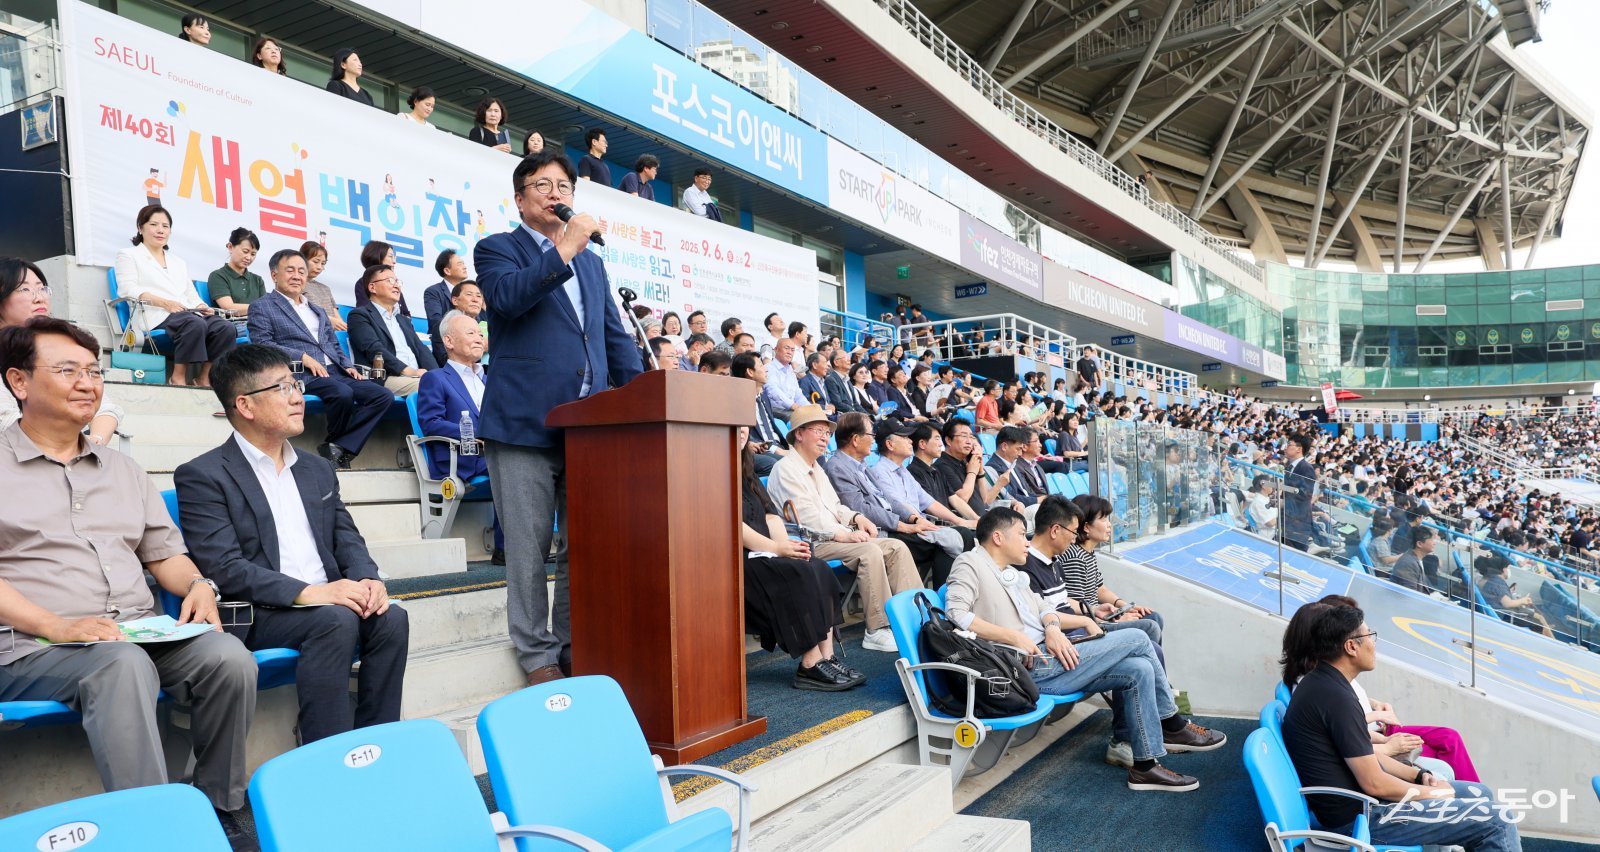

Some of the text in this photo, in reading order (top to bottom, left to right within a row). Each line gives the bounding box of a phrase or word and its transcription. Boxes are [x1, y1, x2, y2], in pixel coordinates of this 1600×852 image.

[94, 36, 162, 76] SAEUL
[167, 71, 253, 106] Foundation of Culture
[99, 104, 176, 147] 제40회
[651, 63, 803, 181] 포스코이앤씨
[177, 129, 472, 269] 새얼 백일장
[839, 168, 875, 203] START
[897, 198, 922, 227] PARK
[611, 221, 638, 241] 사람은
[640, 226, 667, 251] 놀고,
[622, 251, 647, 271] 사람은
[649, 255, 676, 279] 읽고,
[980, 237, 999, 270] ifez
[644, 280, 670, 304] 써라!
[1068, 280, 1108, 313] INCHEON
[1109, 297, 1136, 321] UNITED
[1178, 322, 1202, 347] INCHEON
[1202, 331, 1221, 353] UNITED
[444, 484, 452, 495] H
[550, 697, 567, 709] F-12
[961, 728, 969, 742] F
[351, 748, 373, 765] F-11
[49, 827, 85, 850] F-10
